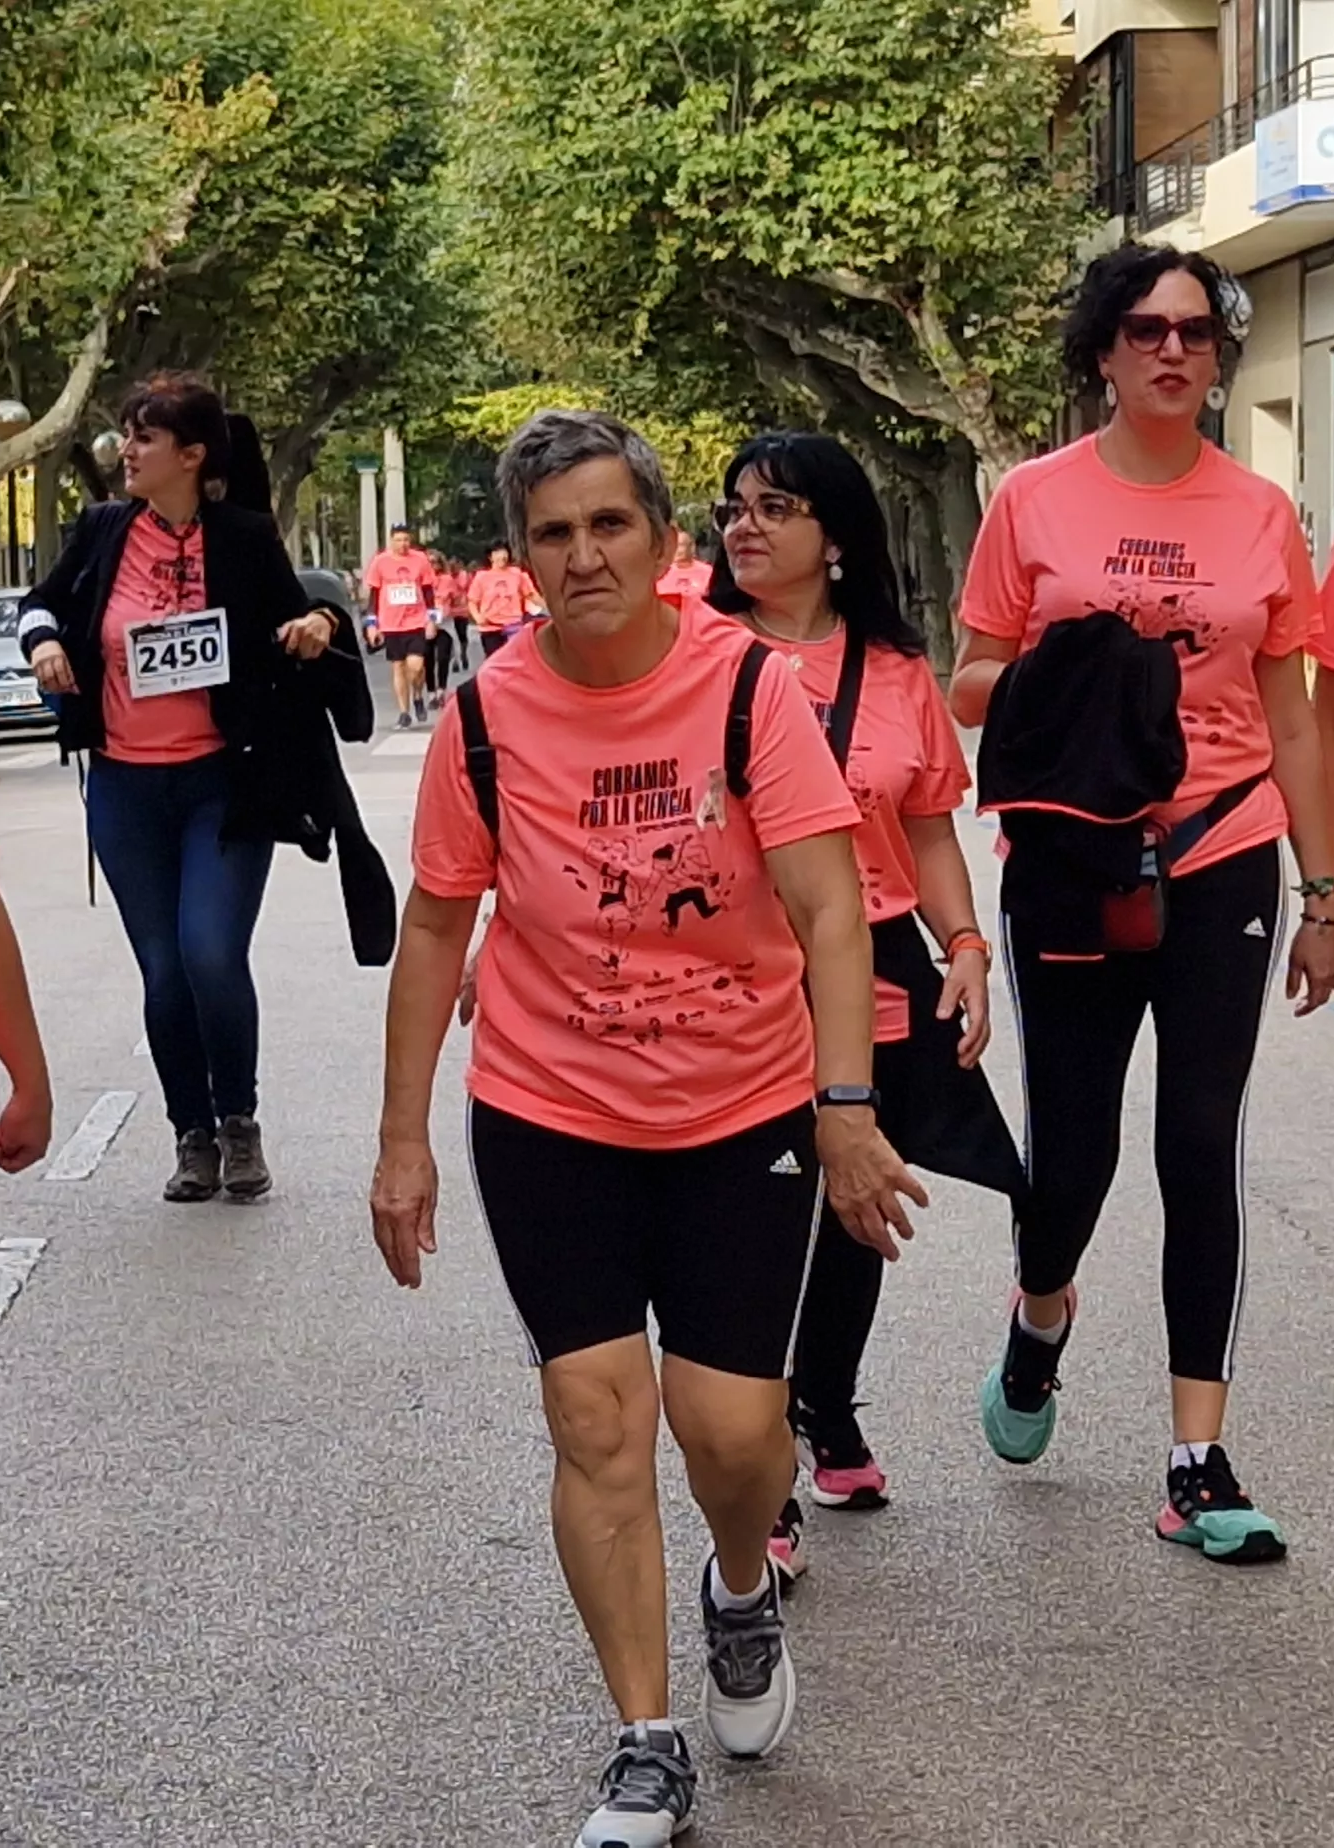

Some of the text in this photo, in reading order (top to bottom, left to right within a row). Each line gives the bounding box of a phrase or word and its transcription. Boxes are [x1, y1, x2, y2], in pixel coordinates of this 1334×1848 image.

[138, 636, 219, 674] 2450
[614, 796, 629, 825] LA
[635, 786, 692, 823] CIENCIA
